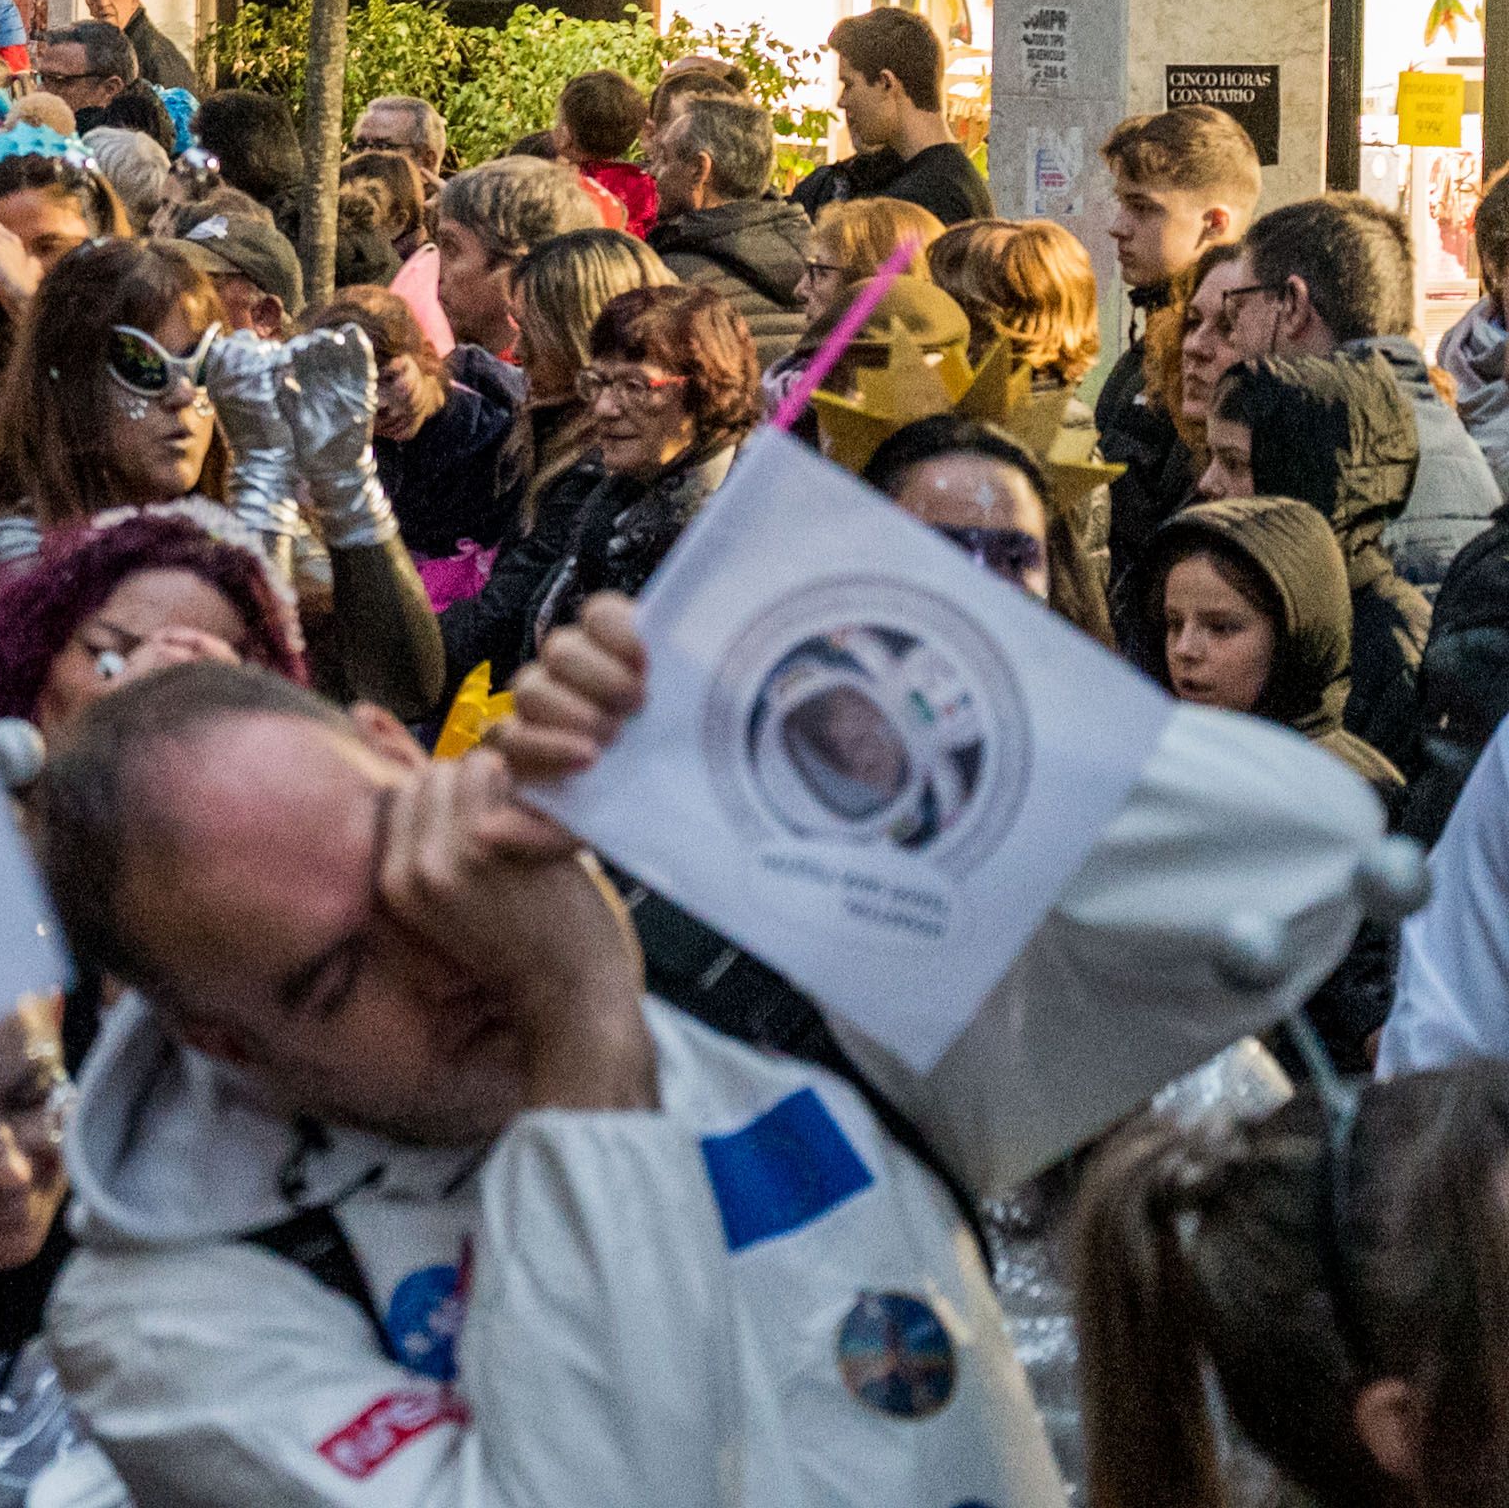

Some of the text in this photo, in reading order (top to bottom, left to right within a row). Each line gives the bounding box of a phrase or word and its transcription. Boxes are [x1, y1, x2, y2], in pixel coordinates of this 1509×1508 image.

[1170, 72, 1271, 87] CINCO HORAS
[1170, 88, 1256, 103] CON MARIO
